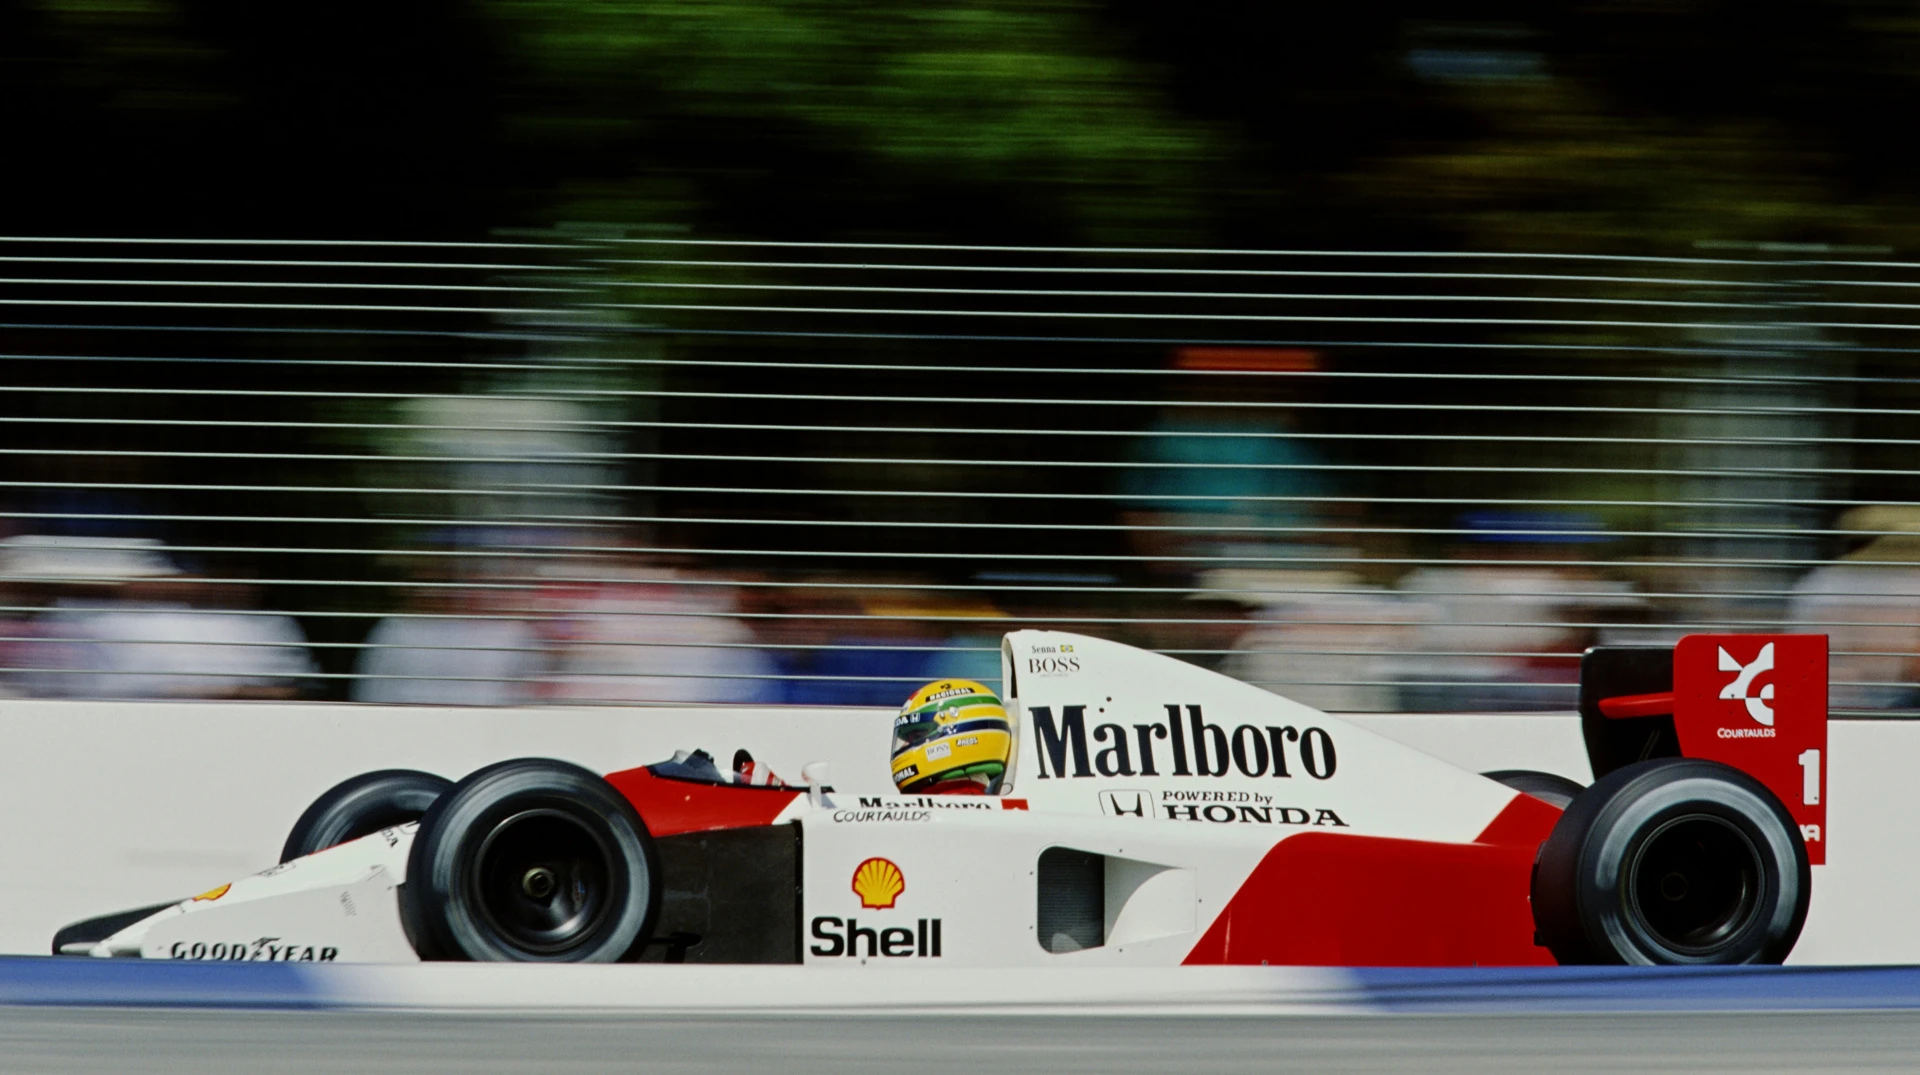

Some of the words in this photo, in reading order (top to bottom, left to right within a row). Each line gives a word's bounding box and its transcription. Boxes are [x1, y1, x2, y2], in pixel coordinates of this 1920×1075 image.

[1031, 645, 1057, 654] Senna
[1028, 656, 1081, 674] BOSS
[930, 688, 971, 700] NACIONAL
[1028, 704, 1337, 780] Marlboro
[1717, 728, 1776, 738] COURTAULDS
[1798, 749, 1820, 805] 1
[1162, 790, 1251, 803] POWERED
[1254, 792, 1274, 805] by
[833, 810, 932, 823] COURTAULDS
[1162, 804, 1351, 828] HONDA
[810, 916, 941, 957] Shell
[170, 938, 340, 962] GOODYEAR
